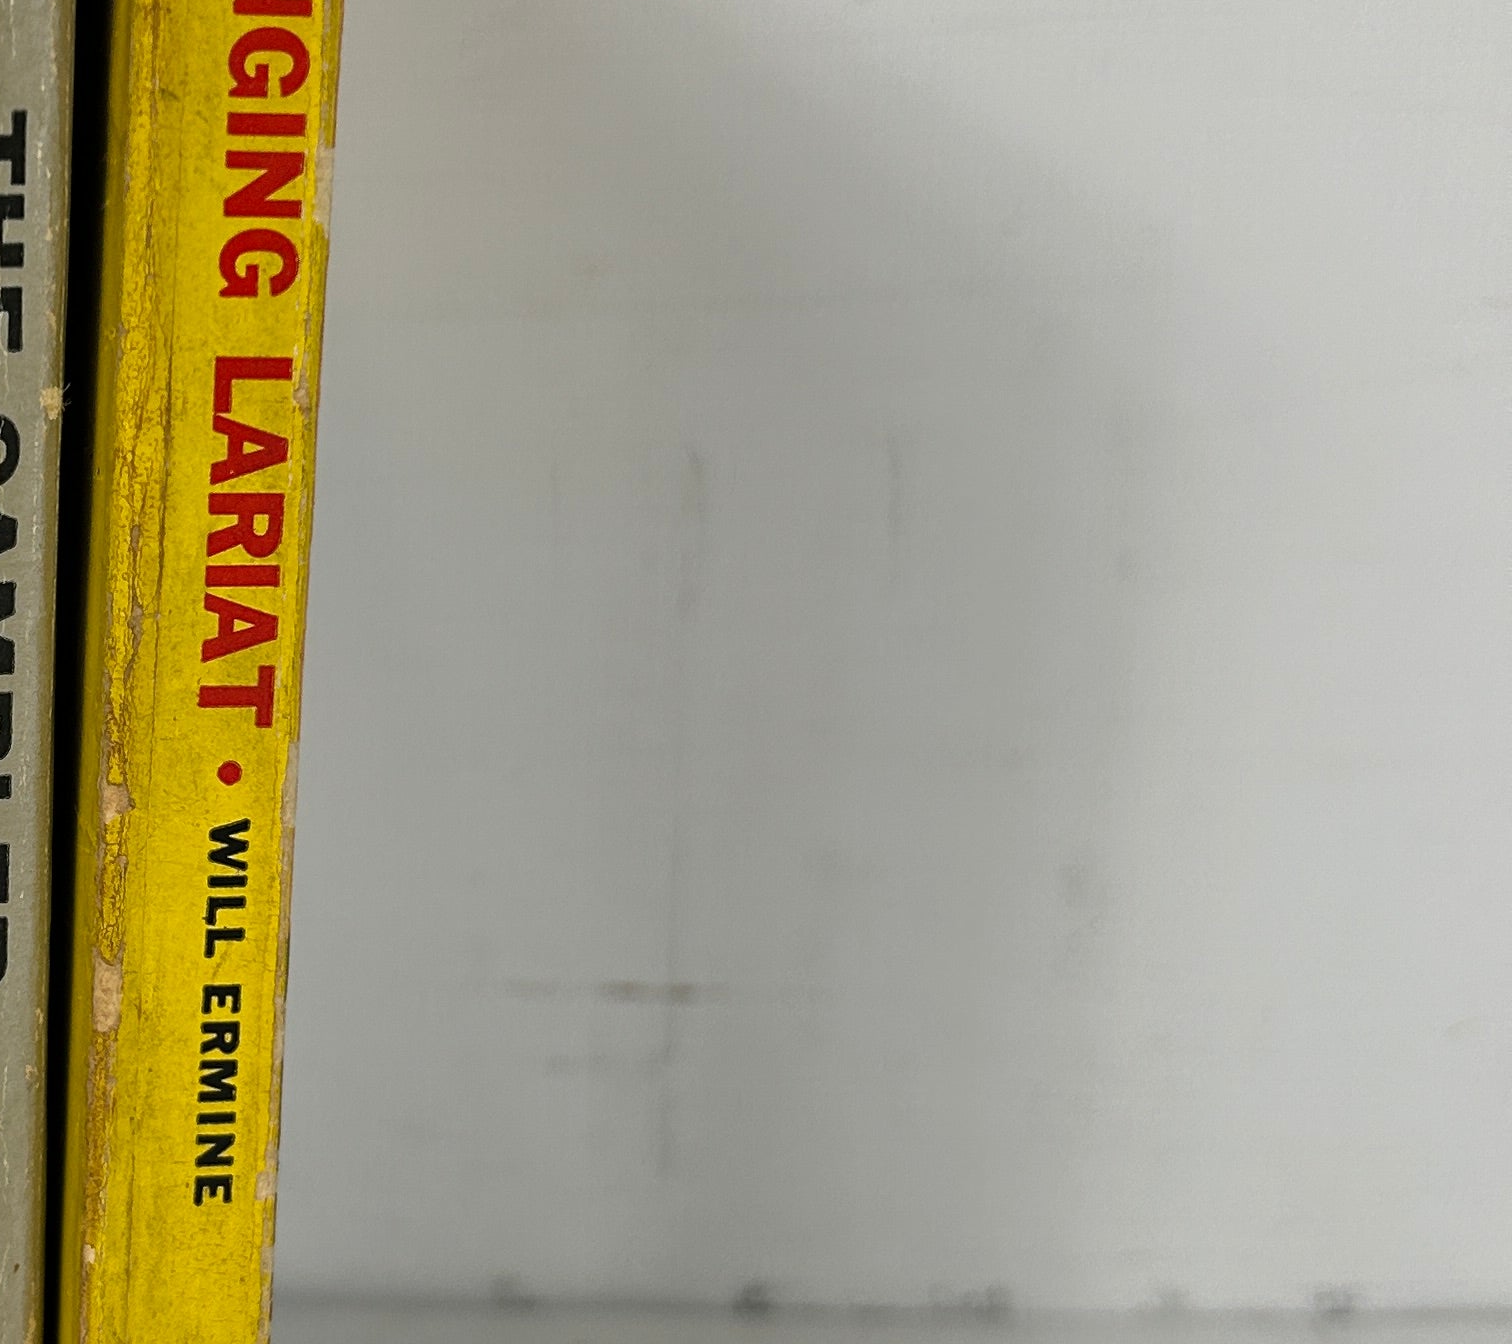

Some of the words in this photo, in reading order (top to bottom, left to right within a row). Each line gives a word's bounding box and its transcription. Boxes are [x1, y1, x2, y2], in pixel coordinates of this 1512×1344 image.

[196, 355, 294, 729] LARIAT
[202, 818, 251, 959] WILL
[192, 983, 242, 1206] ERMINE
